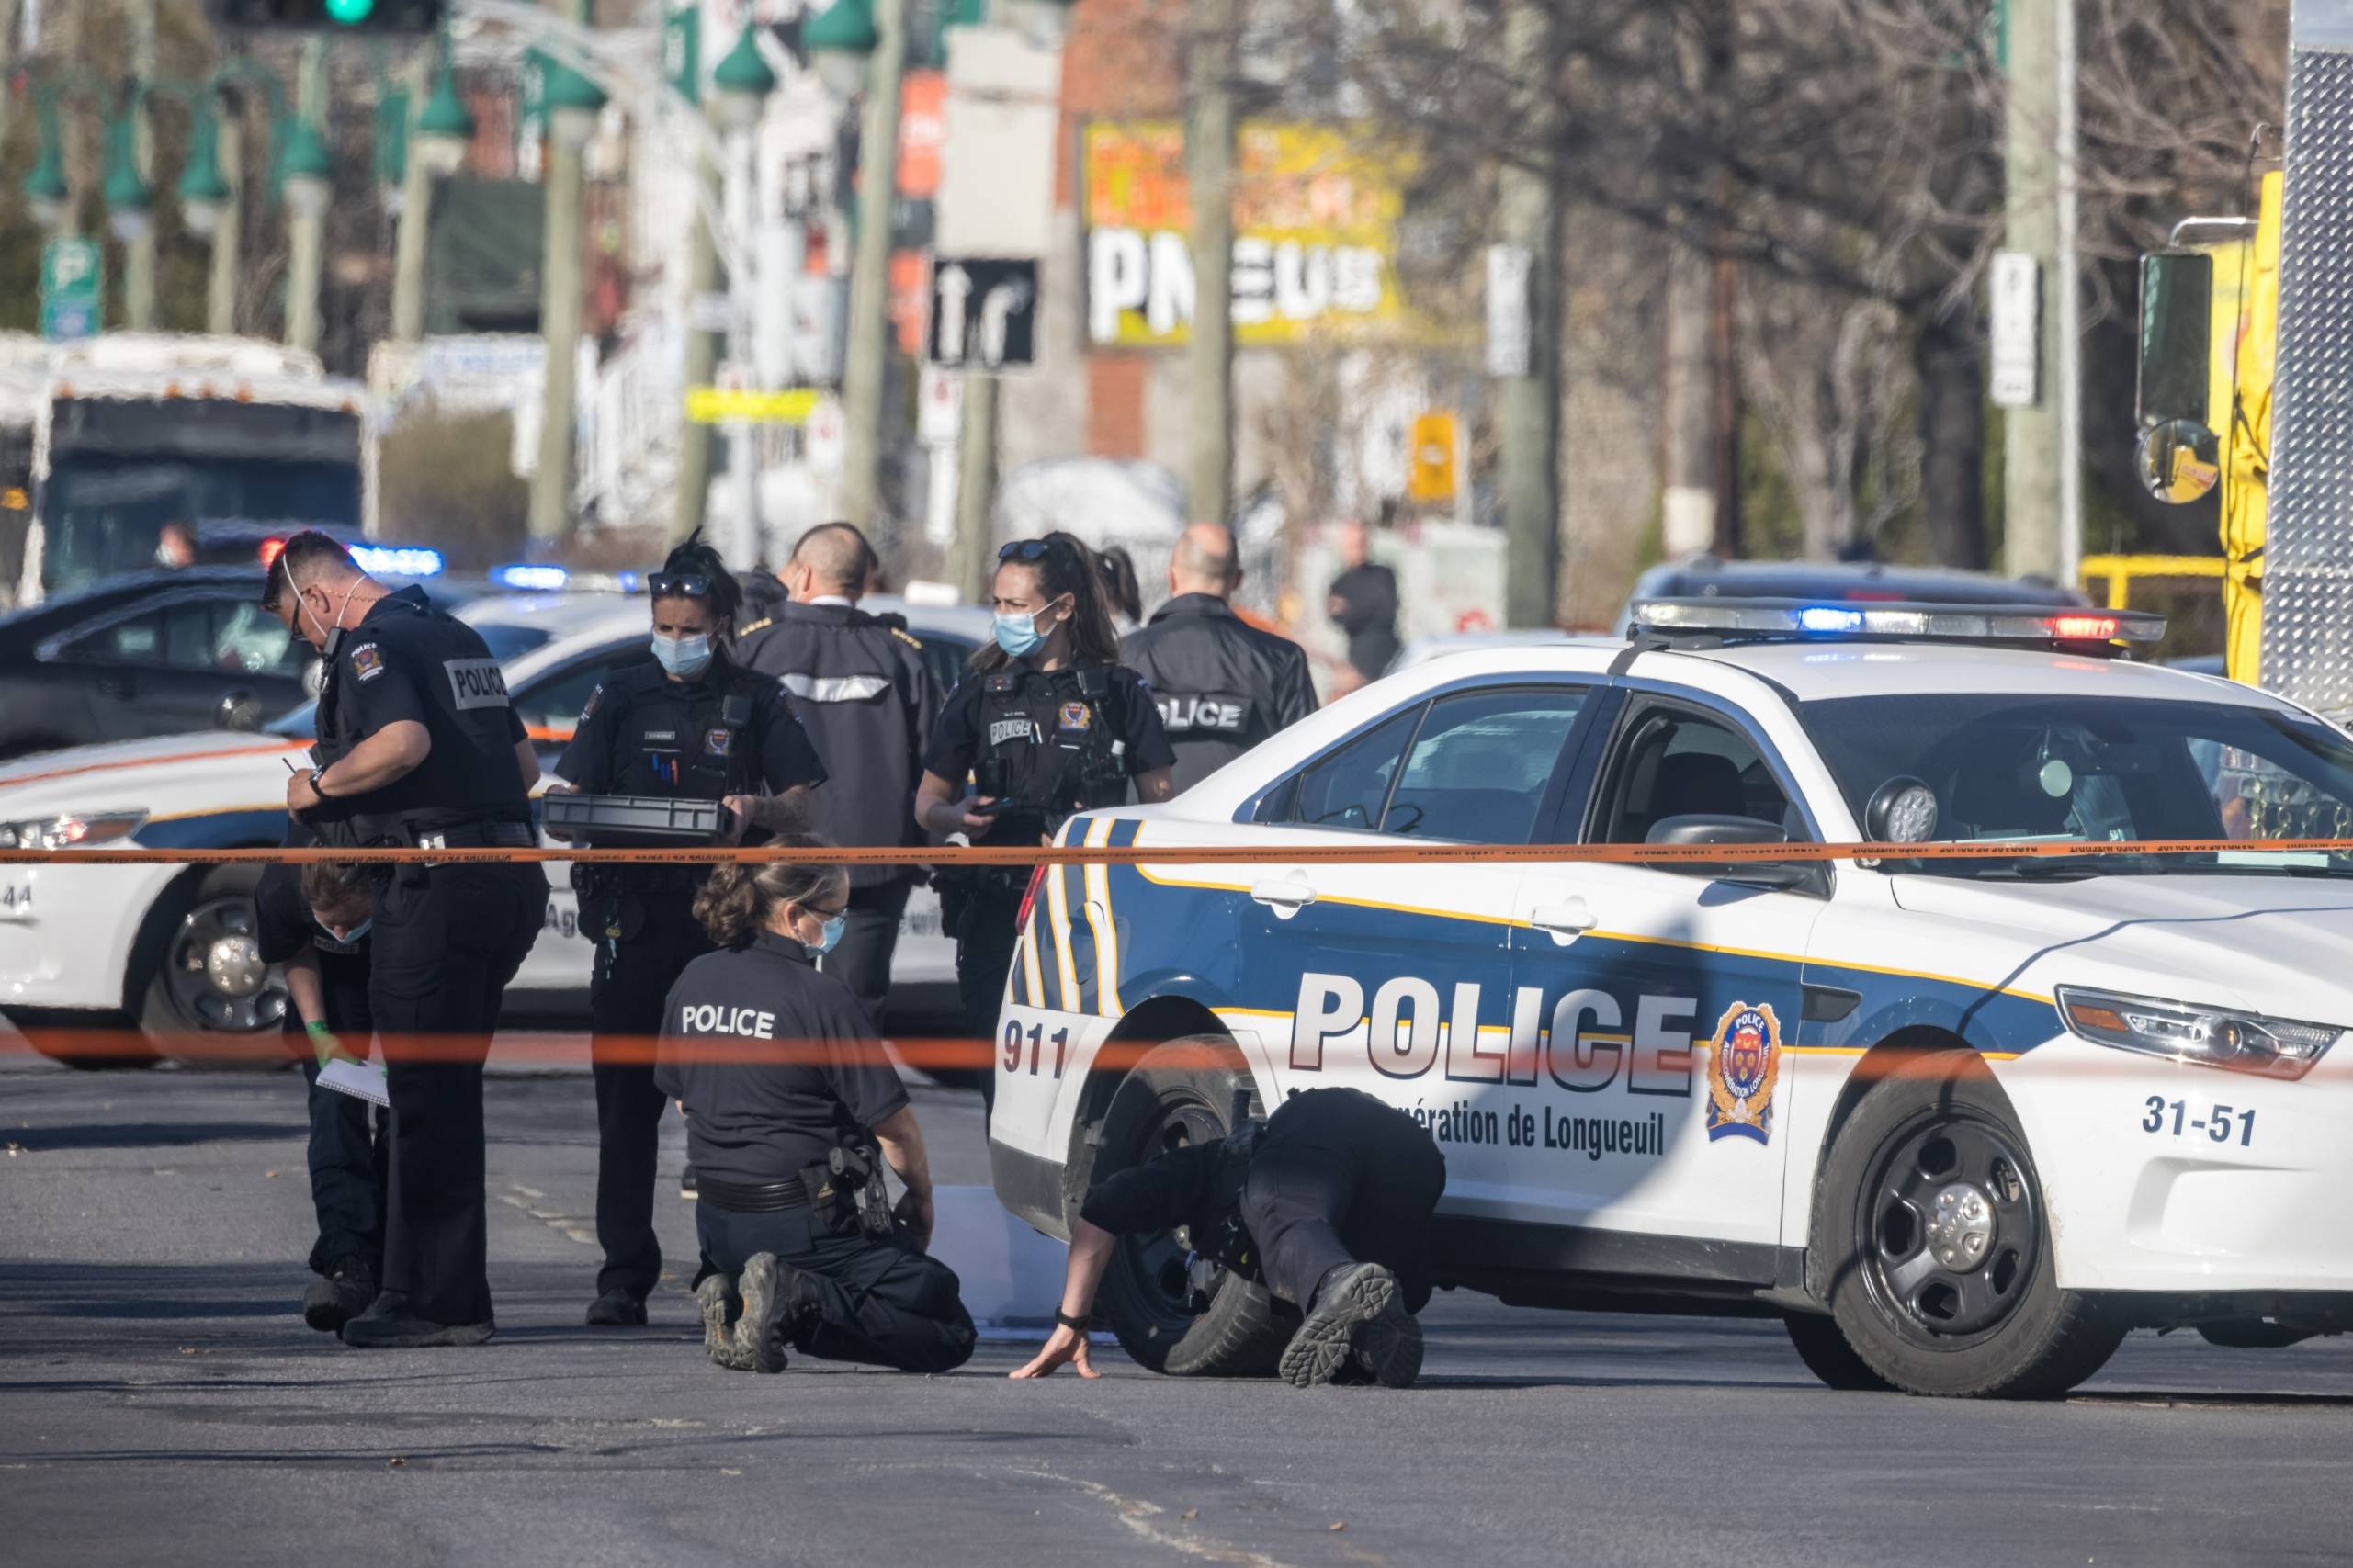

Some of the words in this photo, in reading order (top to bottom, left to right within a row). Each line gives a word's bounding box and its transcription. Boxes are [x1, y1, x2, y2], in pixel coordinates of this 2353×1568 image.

[350, 642, 378, 659] POLICE
[454, 666, 508, 699] POLICE
[1157, 698, 1242, 728] LICE
[990, 721, 1028, 742] POLICE
[682, 1005, 775, 1040] POLICE
[1289, 972, 1698, 1098] POLICE
[1735, 1012, 1765, 1032] POLICE
[1003, 1019, 1069, 1079] 911
[1397, 1097, 1499, 1145] ération
[1507, 1103, 1535, 1146] de
[1544, 1105, 1664, 1161] Longueuil
[2142, 1095, 2257, 1146] 31-51
